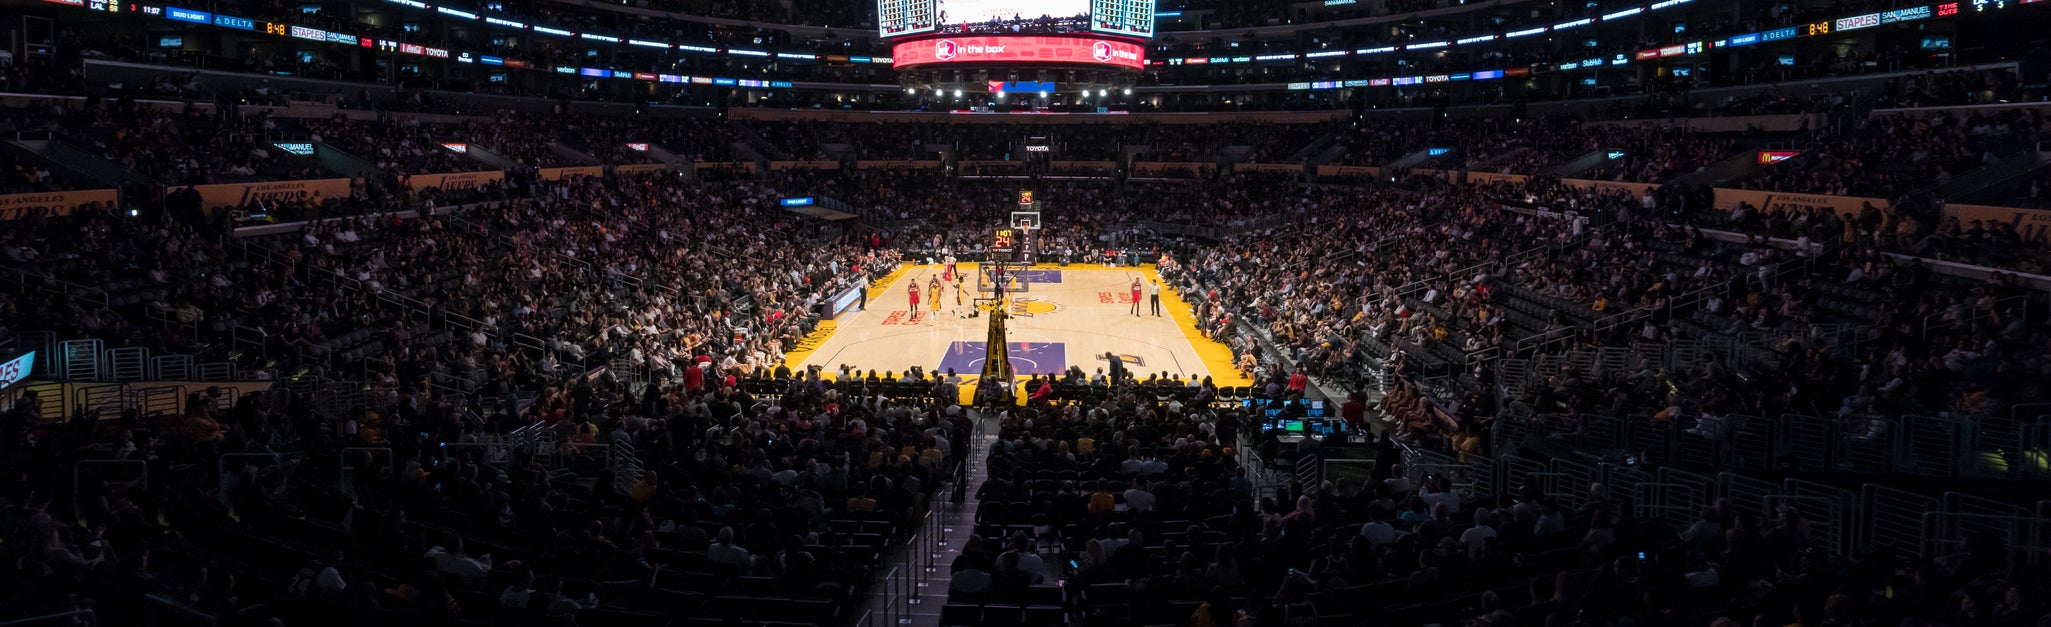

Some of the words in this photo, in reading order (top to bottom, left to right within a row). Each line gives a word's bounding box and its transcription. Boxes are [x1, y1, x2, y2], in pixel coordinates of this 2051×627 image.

[143, 6, 161, 15] 11:07
[1937, 2, 1958, 10] TIME
[187, 13, 205, 21] LIGHT
[1881, 11, 1896, 19] SAN
[1900, 6, 1931, 16] MANUEL
[1937, 8, 1959, 17] OUTS
[224, 18, 254, 29] DELTA
[1837, 15, 1879, 30] STAPLES
[267, 22, 286, 36] 8:48
[1809, 21, 1829, 36] 8:48
[292, 28, 325, 40] STAPLES
[1769, 29, 1796, 39] DELTA
[426, 48, 449, 58] TOYOTA
[957, 45, 966, 54] in
[968, 45, 983, 54] the
[985, 45, 1006, 54] box
[1112, 49, 1119, 57] in
[1582, 58, 1602, 67] StubHub
[1425, 74, 1450, 82] TOYOTA
[290, 143, 313, 151] MANUEL
[13, 195, 65, 204] ANGELES
[995, 229, 1012, 237] 11:07
[995, 237, 1010, 248] 24
